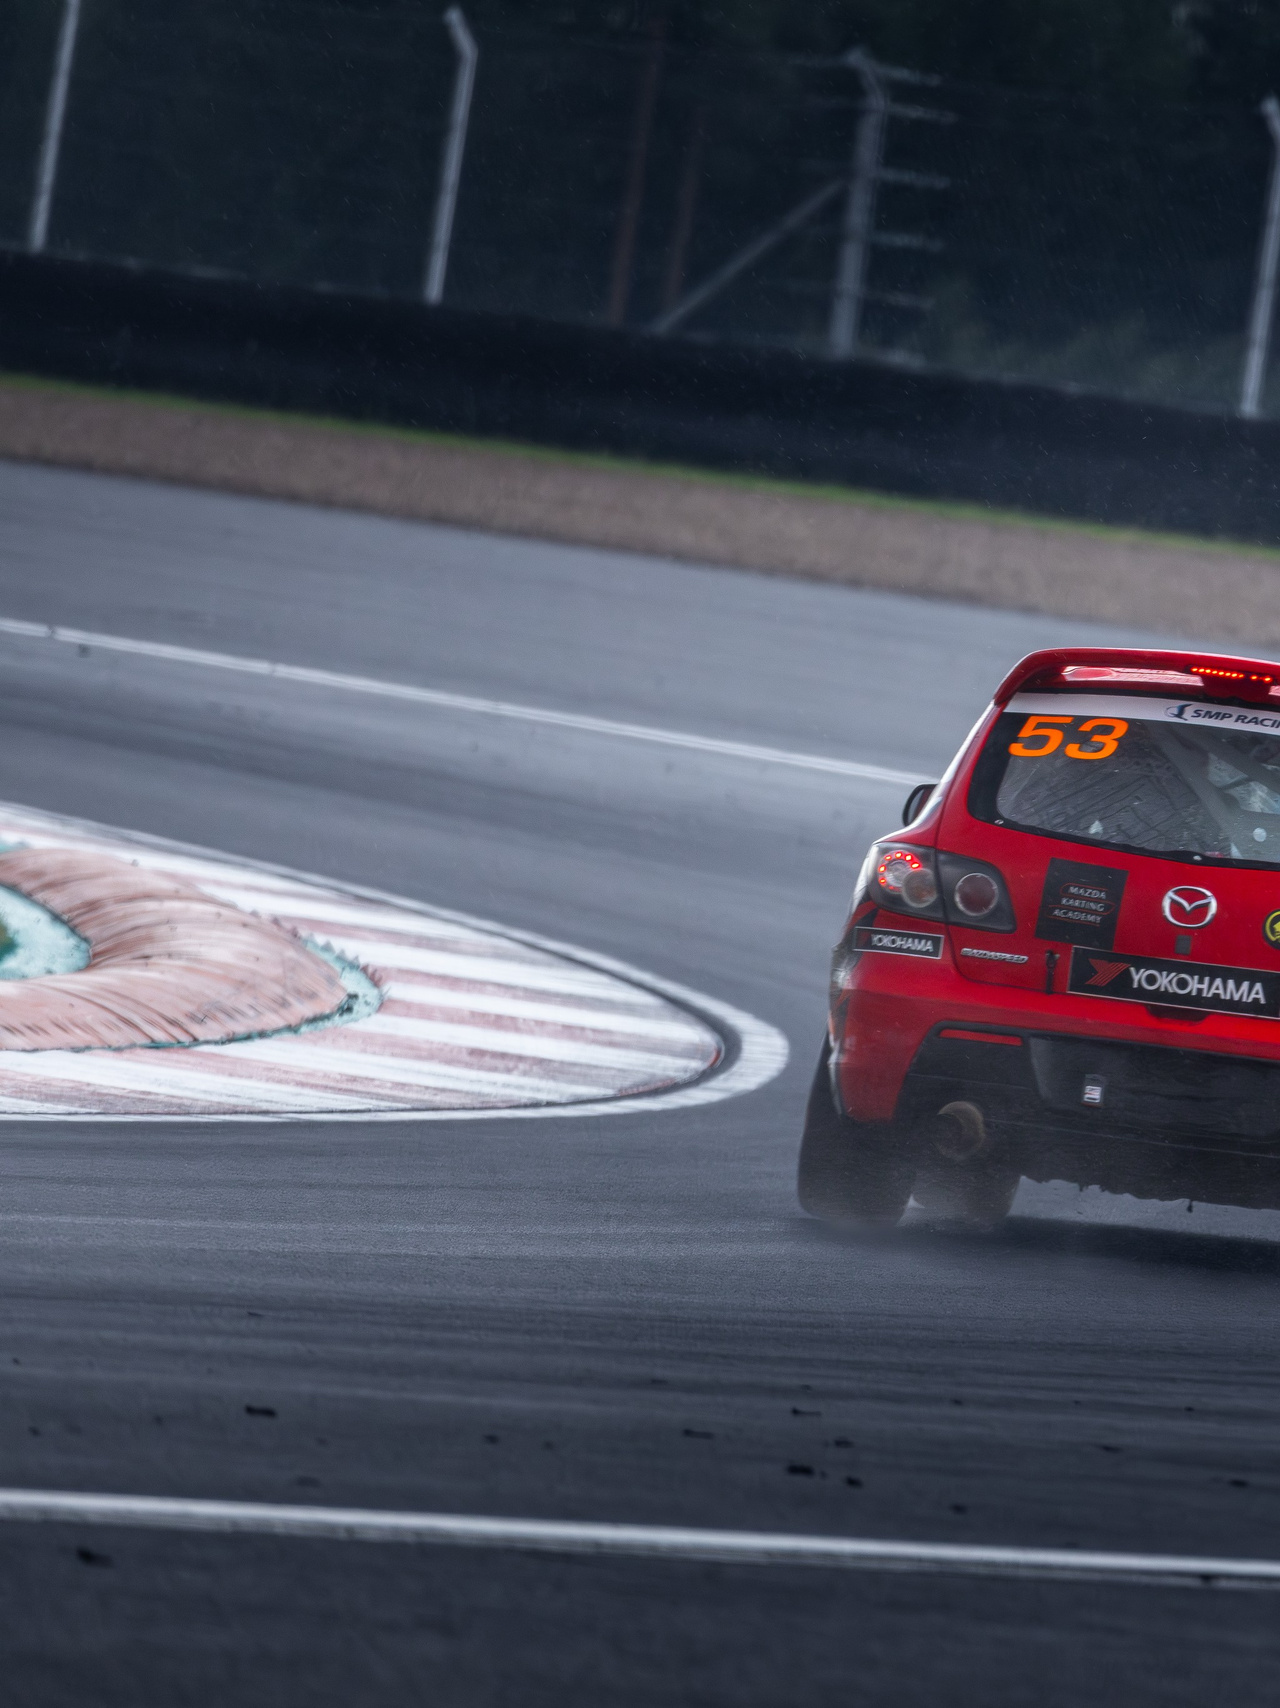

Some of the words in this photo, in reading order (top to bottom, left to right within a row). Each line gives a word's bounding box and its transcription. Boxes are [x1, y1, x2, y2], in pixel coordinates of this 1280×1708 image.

[1189, 708, 1234, 722] SMP
[1007, 714, 1130, 761] 53
[1067, 886, 1107, 900] MAZDA
[1060, 897, 1105, 912] KARTING
[1051, 908, 1102, 923] ACADEMY
[870, 933, 934, 953] YOKOHAMA
[960, 947, 1029, 964] MAZDASPEED
[1128, 966, 1267, 1005] YOKOHAMA
